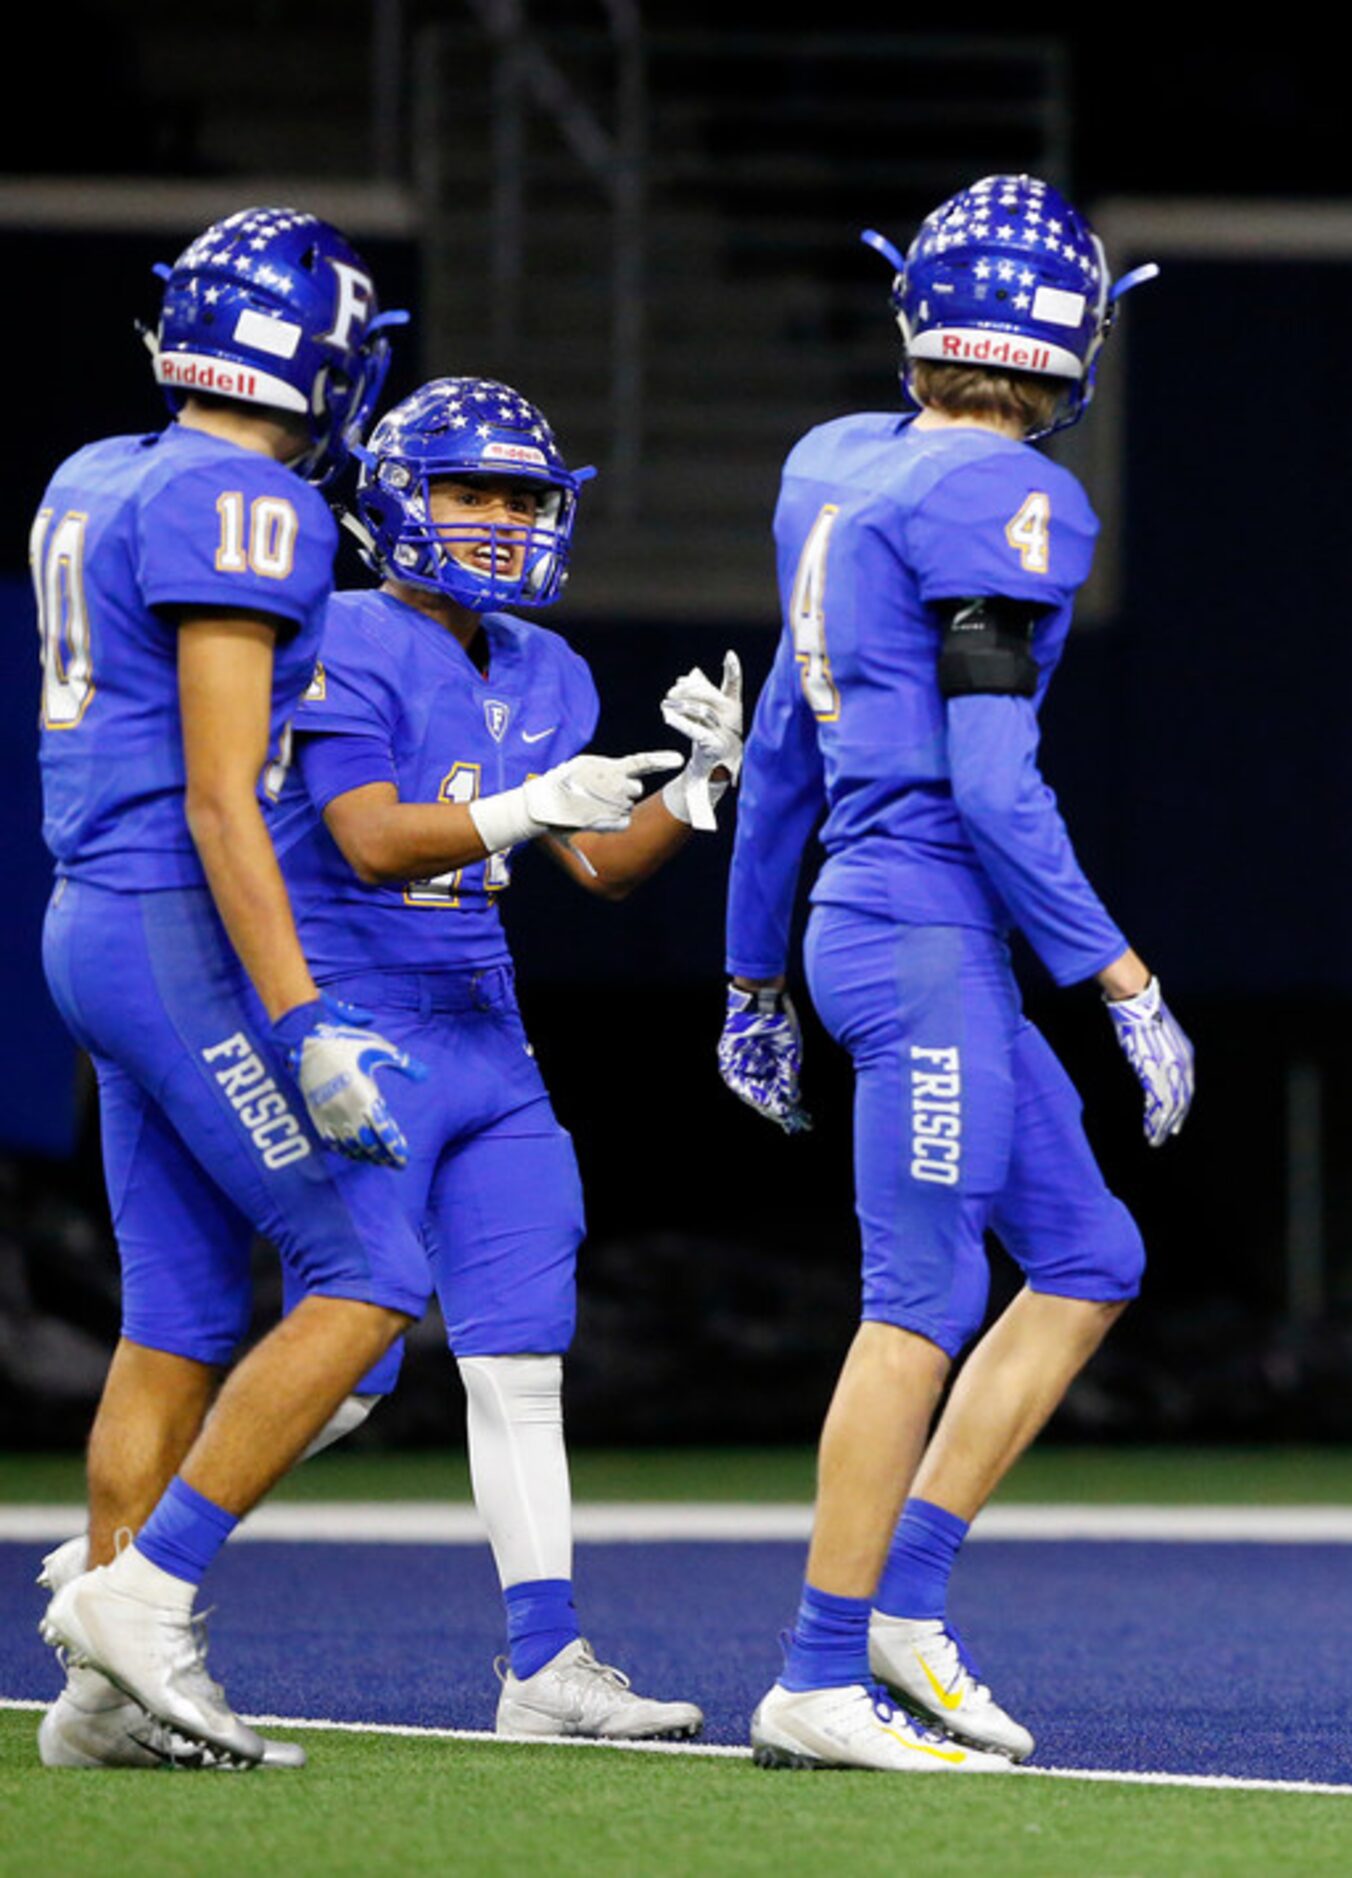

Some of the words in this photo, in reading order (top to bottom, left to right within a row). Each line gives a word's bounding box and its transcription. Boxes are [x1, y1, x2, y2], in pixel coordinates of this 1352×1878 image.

[316, 257, 373, 351] F
[161, 359, 256, 396] Riddell
[942, 334, 1049, 369] Riddell
[215, 491, 298, 580] 10
[1005, 491, 1049, 574] 4
[789, 503, 840, 722] 4
[202, 1032, 310, 1170] FRISCO
[910, 1045, 961, 1185] FRISCO
